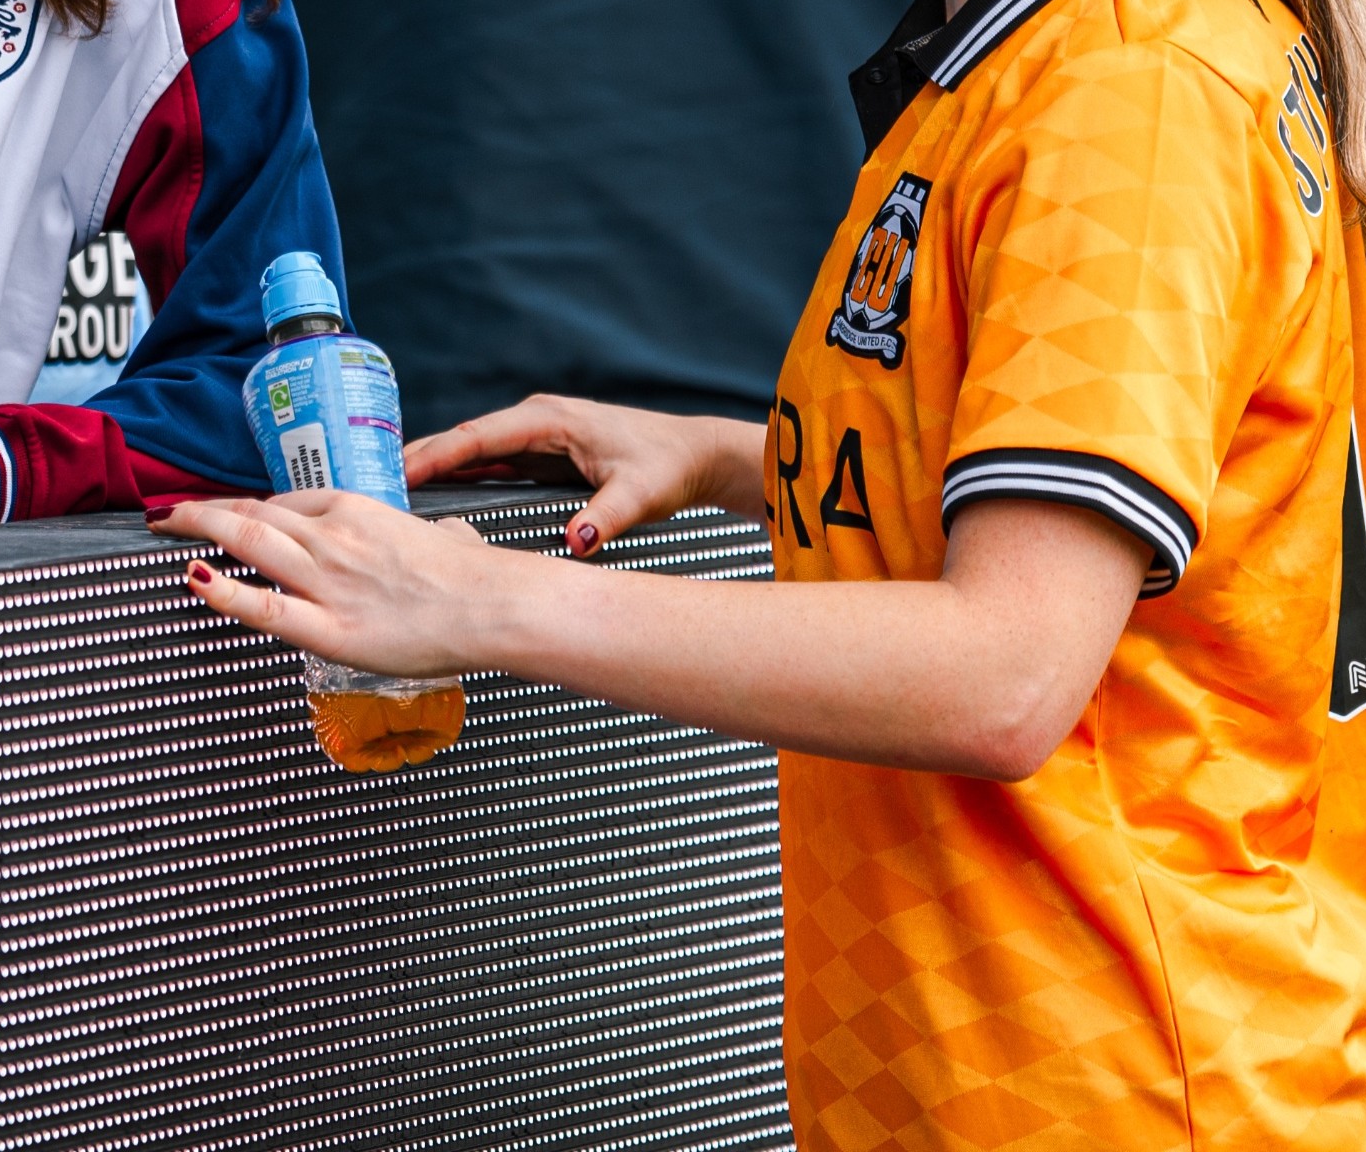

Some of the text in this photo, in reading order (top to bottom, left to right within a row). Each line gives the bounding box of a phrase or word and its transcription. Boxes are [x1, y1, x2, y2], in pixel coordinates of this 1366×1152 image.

[63, 232, 136, 298] GE
[850, 226, 910, 314] CU
[48, 303, 135, 359] ROU
[857, 336, 880, 347] UNITED
[290, 457, 304, 491] RESAL
[297, 444, 314, 489] INDIVIDU
[310, 448, 326, 489] NOT FOR
[765, 394, 878, 553] RA
